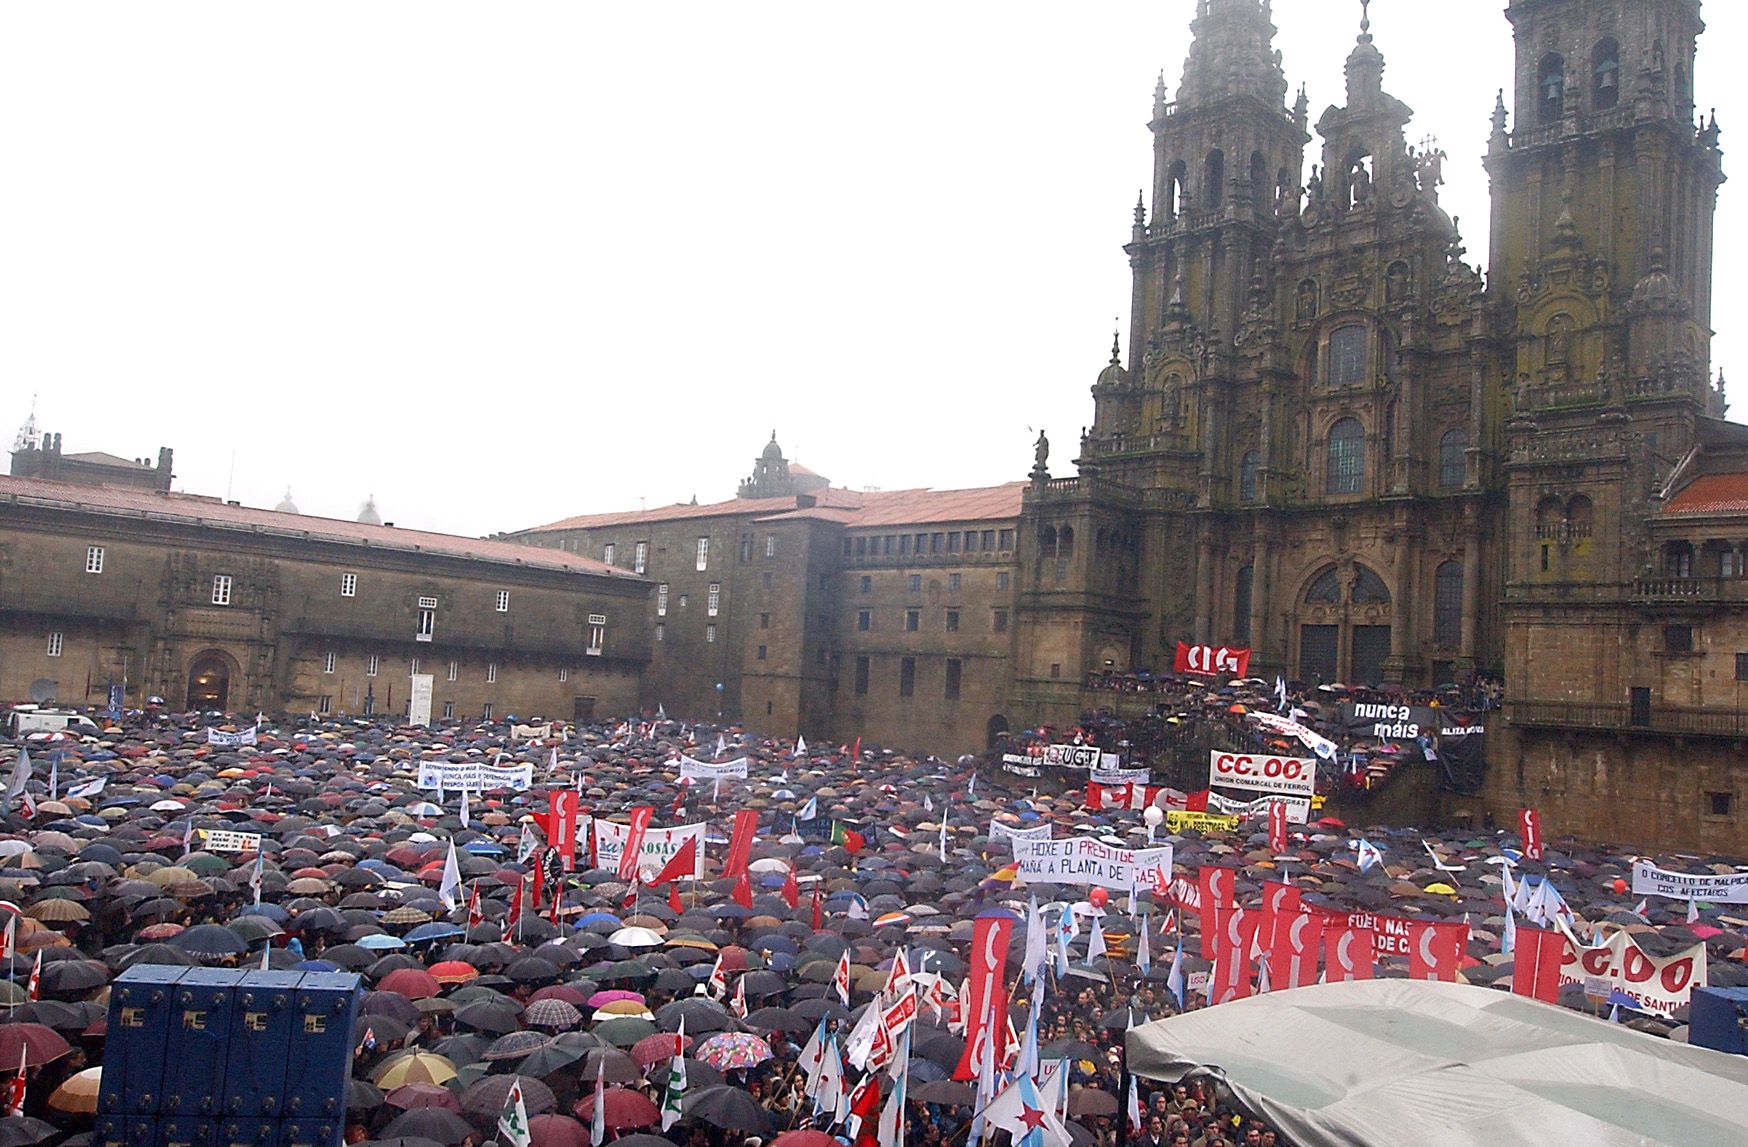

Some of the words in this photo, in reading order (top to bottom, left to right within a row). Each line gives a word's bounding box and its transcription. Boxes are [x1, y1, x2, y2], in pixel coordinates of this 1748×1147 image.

[1187, 645, 1239, 673] CIG
[1354, 703, 1411, 721] nunca
[1373, 720, 1419, 739] máis
[1235, 779, 1272, 789] COMARCAL
[1283, 783, 1311, 792] FERROL
[1524, 809, 1540, 860] CIG
[1031, 842, 1058, 858] HOXE
[1064, 841, 1073, 855] O
[1079, 840, 1135, 864] PRESTIGE
[1047, 862, 1055, 874] A
[1061, 859, 1103, 876] PLANTA
[1109, 865, 1124, 881] DE
[1641, 869, 1648, 878] O
[1650, 871, 1695, 885] CONCELLO
[1699, 878, 1711, 886] DE
[1680, 887, 1728, 897] AFECTADOS
[1349, 912, 1380, 932] FUEL
[1378, 935, 1395, 951] DE
